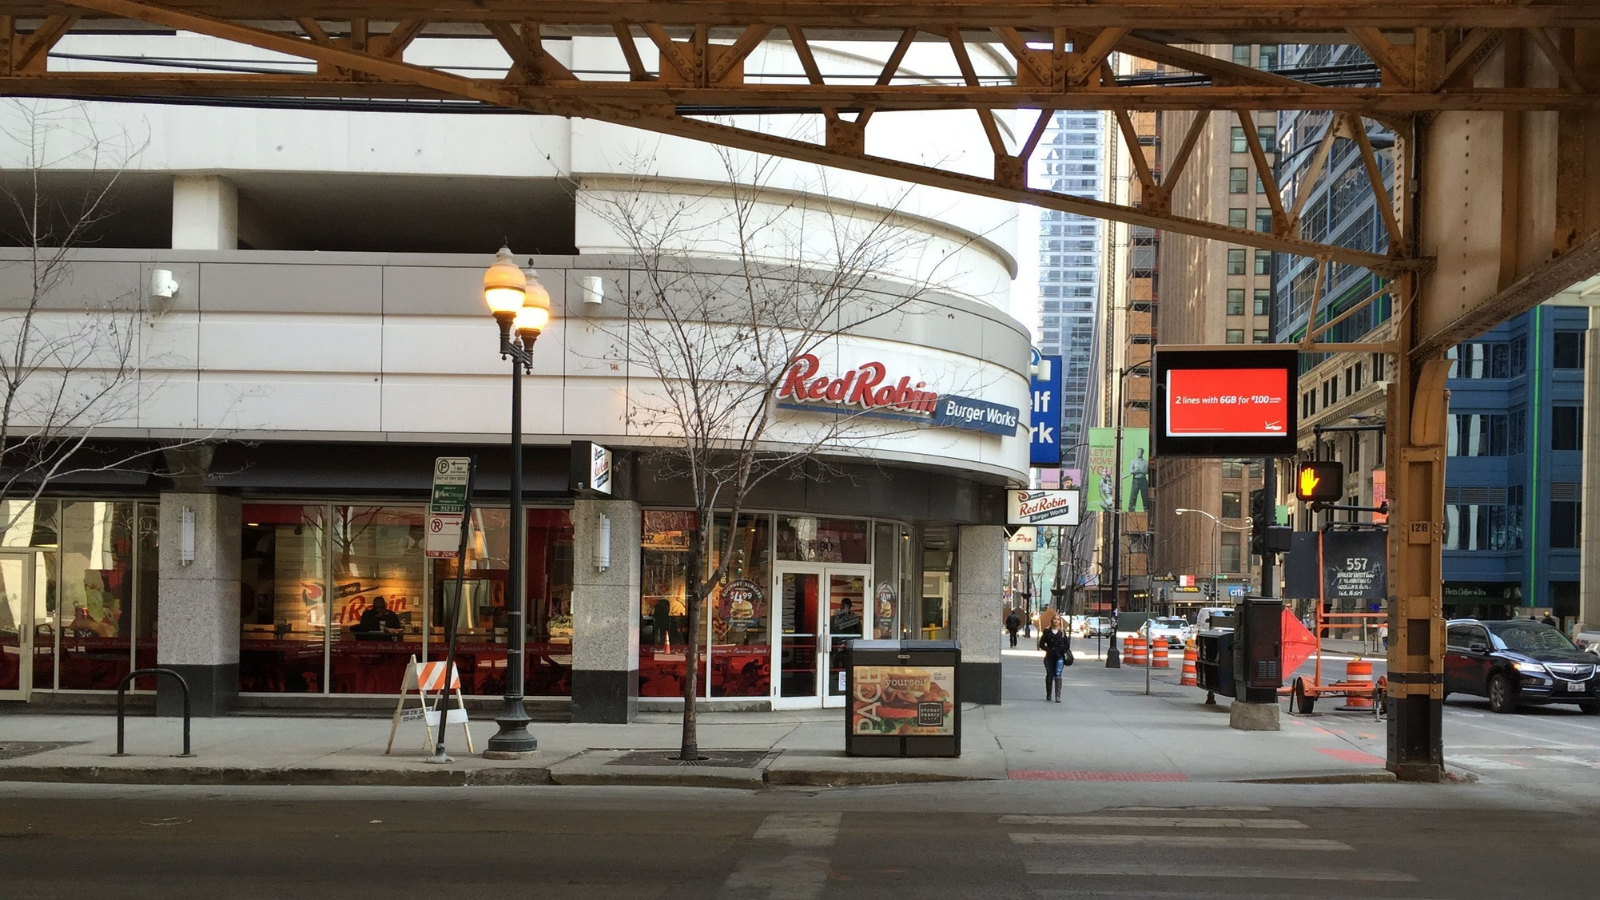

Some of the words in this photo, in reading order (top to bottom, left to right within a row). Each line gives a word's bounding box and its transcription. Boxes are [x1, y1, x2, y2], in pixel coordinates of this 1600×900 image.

[778, 353, 856, 401] Red
[850, 361, 938, 413] Robin
[1030, 391, 1050, 412] lf
[1175, 396, 1181, 404] 2
[1182, 396, 1200, 404] lines
[1202, 395, 1218, 404] with
[1220, 395, 1236, 404] 6GB
[1238, 396, 1250, 405] for
[1251, 395, 1269, 404] $100
[946, 400, 985, 422] Burger
[986, 407, 1016, 427] Works
[1090, 457, 1113, 465] MOVE
[1090, 465, 1113, 476] YOU
[1020, 502, 1039, 516] Red
[1039, 497, 1067, 510] Robin
[1032, 513, 1050, 521] Burger
[1050, 508, 1067, 517] Works
[1411, 523, 1428, 532] 128
[1016, 533, 1032, 543] Pro
[1346, 557, 1368, 570] 557
[722, 581, 742, 598] GOURMET
[744, 582, 763, 599] BURGERS
[349, 594, 407, 623] Rin
[885, 677, 929, 688] yourself
[857, 667, 881, 734] PACE
